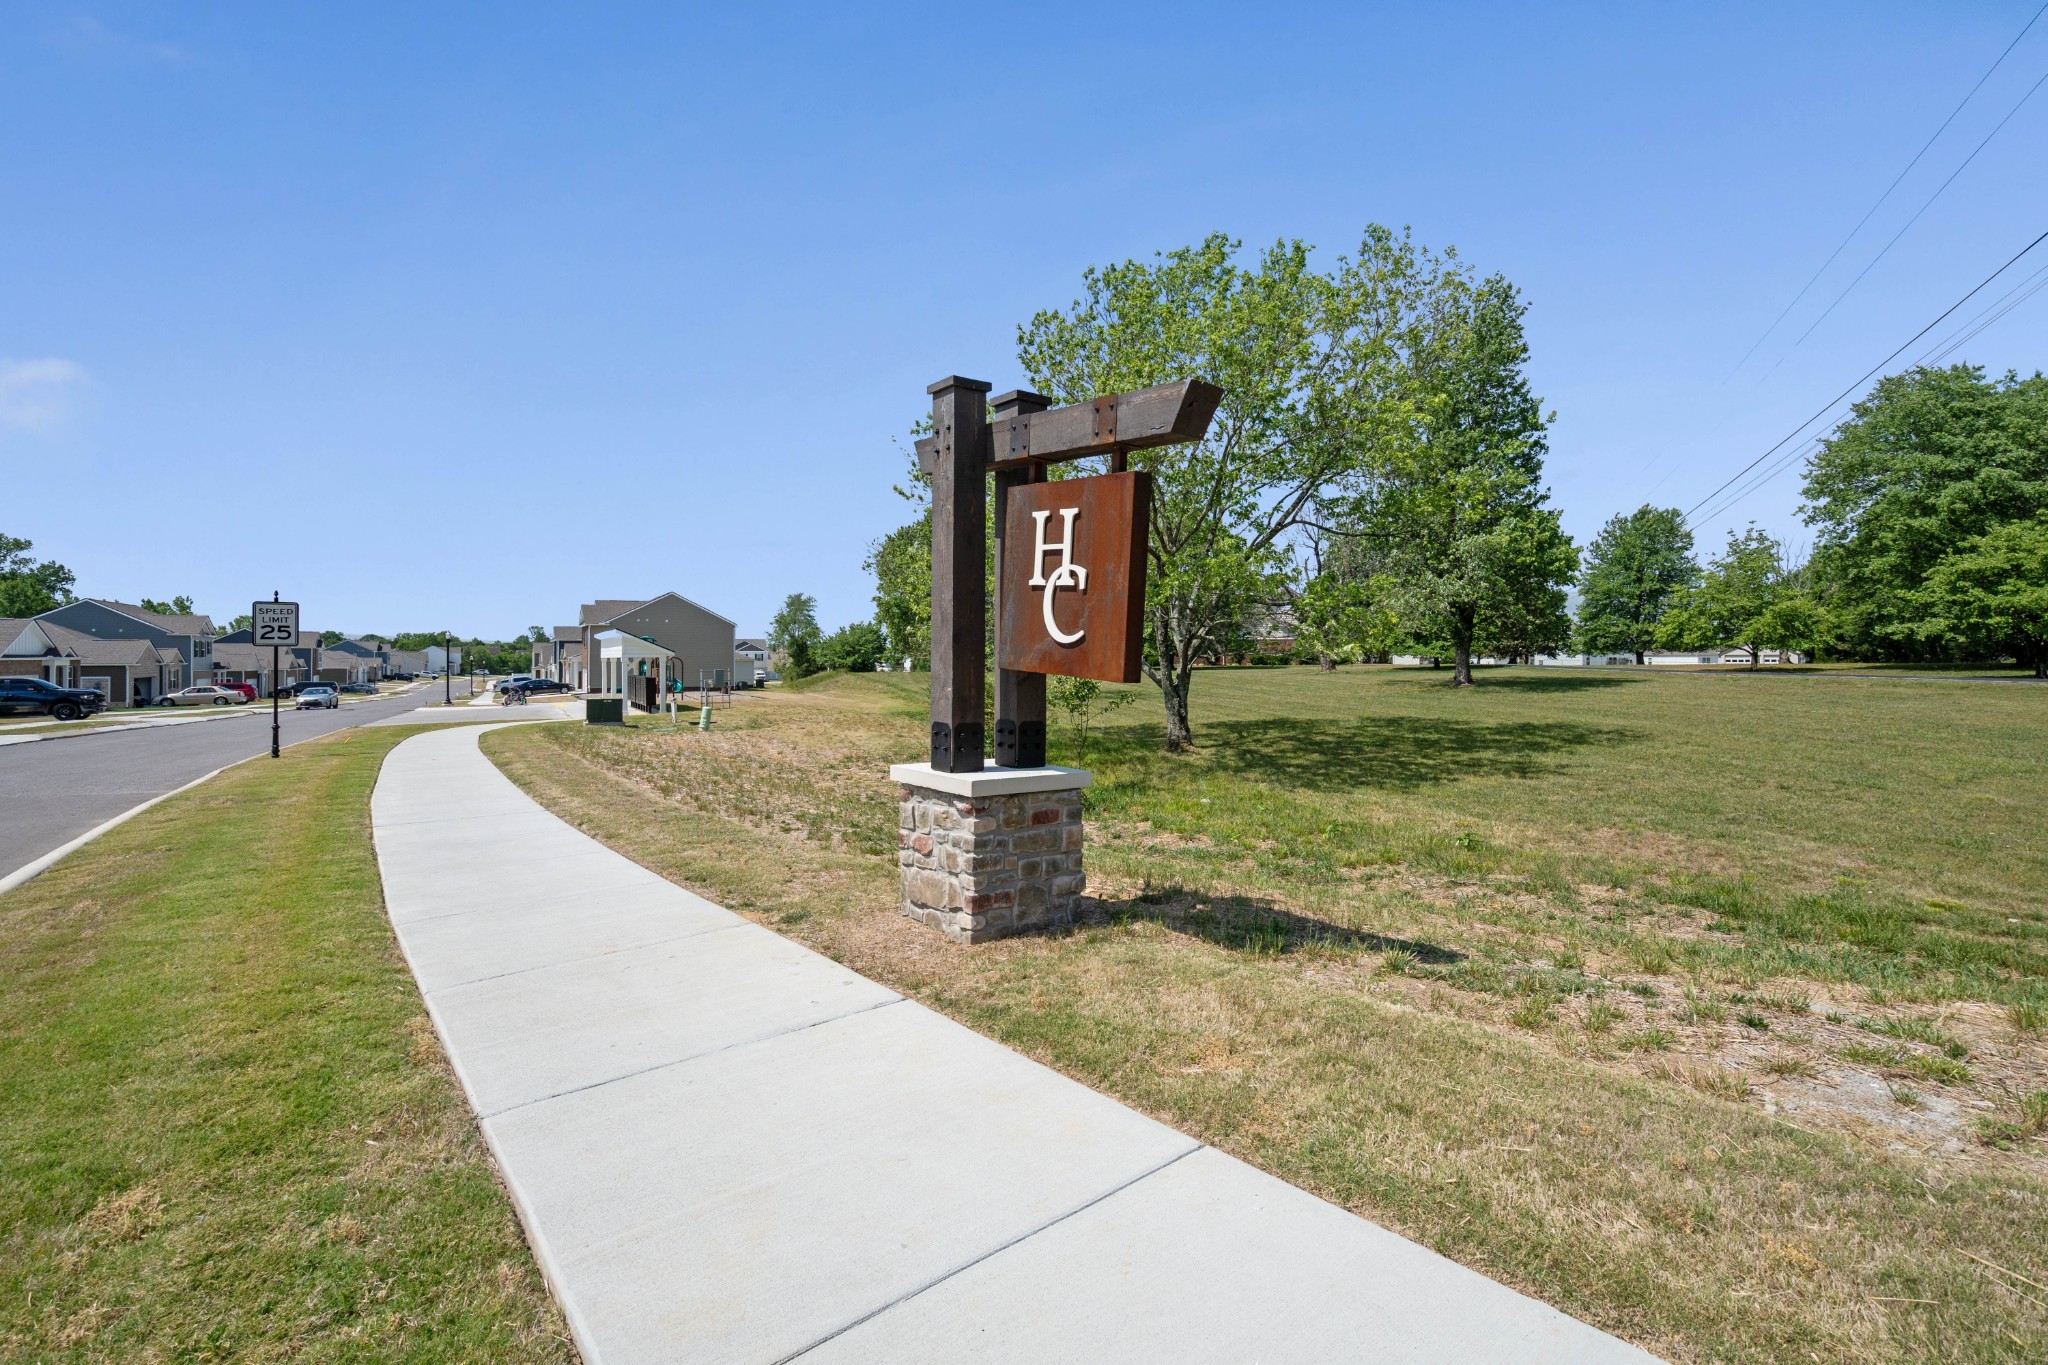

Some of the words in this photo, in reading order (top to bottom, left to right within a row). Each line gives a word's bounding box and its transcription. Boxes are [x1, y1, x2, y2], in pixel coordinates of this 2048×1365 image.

[258, 607, 294, 615] SPEED
[262, 616, 290, 624] LIMIT
[260, 624, 292, 640] 25
